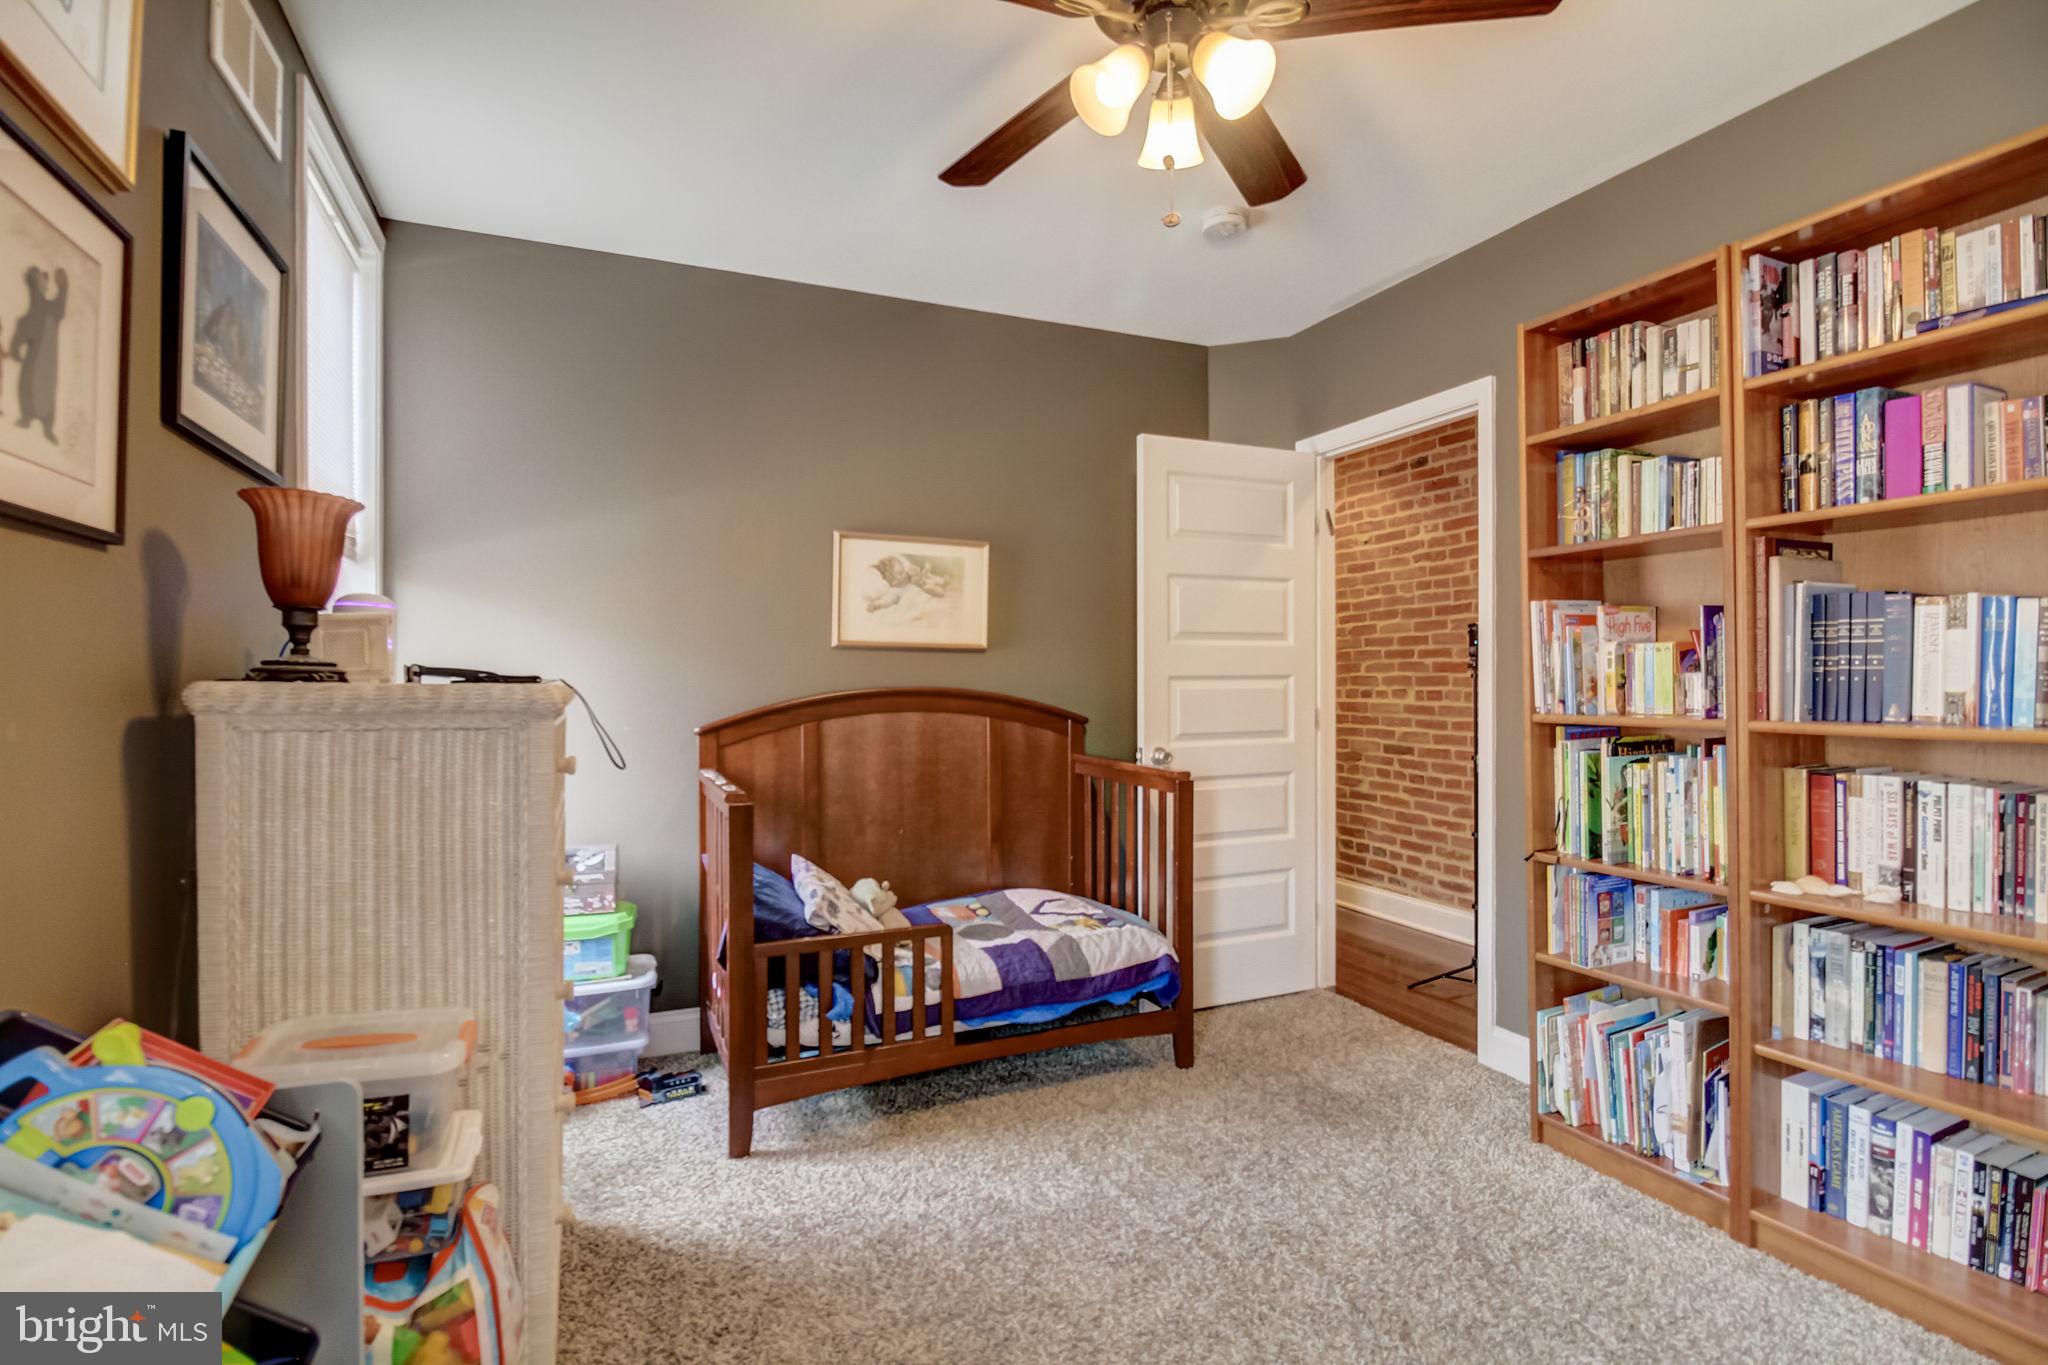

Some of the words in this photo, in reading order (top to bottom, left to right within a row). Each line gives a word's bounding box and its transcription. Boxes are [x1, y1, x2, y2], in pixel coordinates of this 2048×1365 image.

[1836, 462, 1854, 499] PASS
[1605, 616, 1632, 638] High
[1633, 614, 1652, 633] Five
[1886, 791, 1898, 805] SIX
[1921, 801, 1929, 814] For
[1933, 795, 1942, 818] PULPIT
[1886, 808, 1898, 829] DAYS
[1933, 819, 1942, 843] POWER
[1887, 843, 1899, 862] WAR
[1921, 853, 1929, 872] Sake
[1830, 1106, 1843, 1160] AMERICA'S
[1830, 1160, 1842, 1191] GAME
[1897, 1161, 1908, 1217] MATHLETICS
